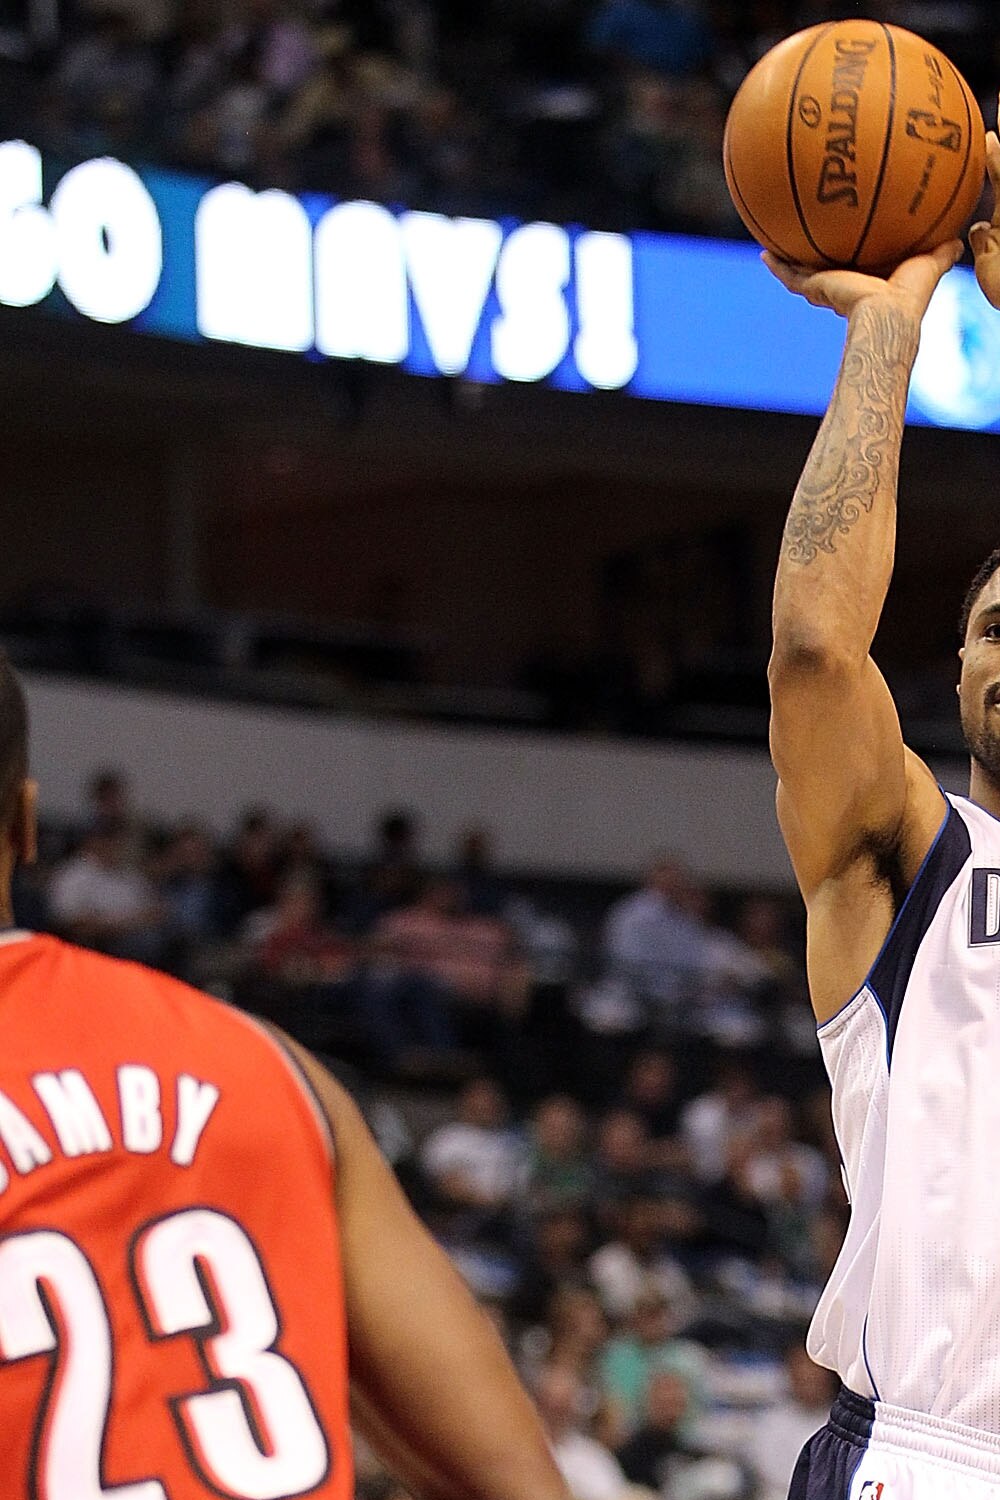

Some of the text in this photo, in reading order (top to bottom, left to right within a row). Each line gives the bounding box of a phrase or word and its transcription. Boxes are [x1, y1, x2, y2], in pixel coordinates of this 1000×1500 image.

[816, 39, 878, 208] SPALDING
[194, 181, 639, 390] MAVS!
[0, 1063, 221, 1198] AMBY
